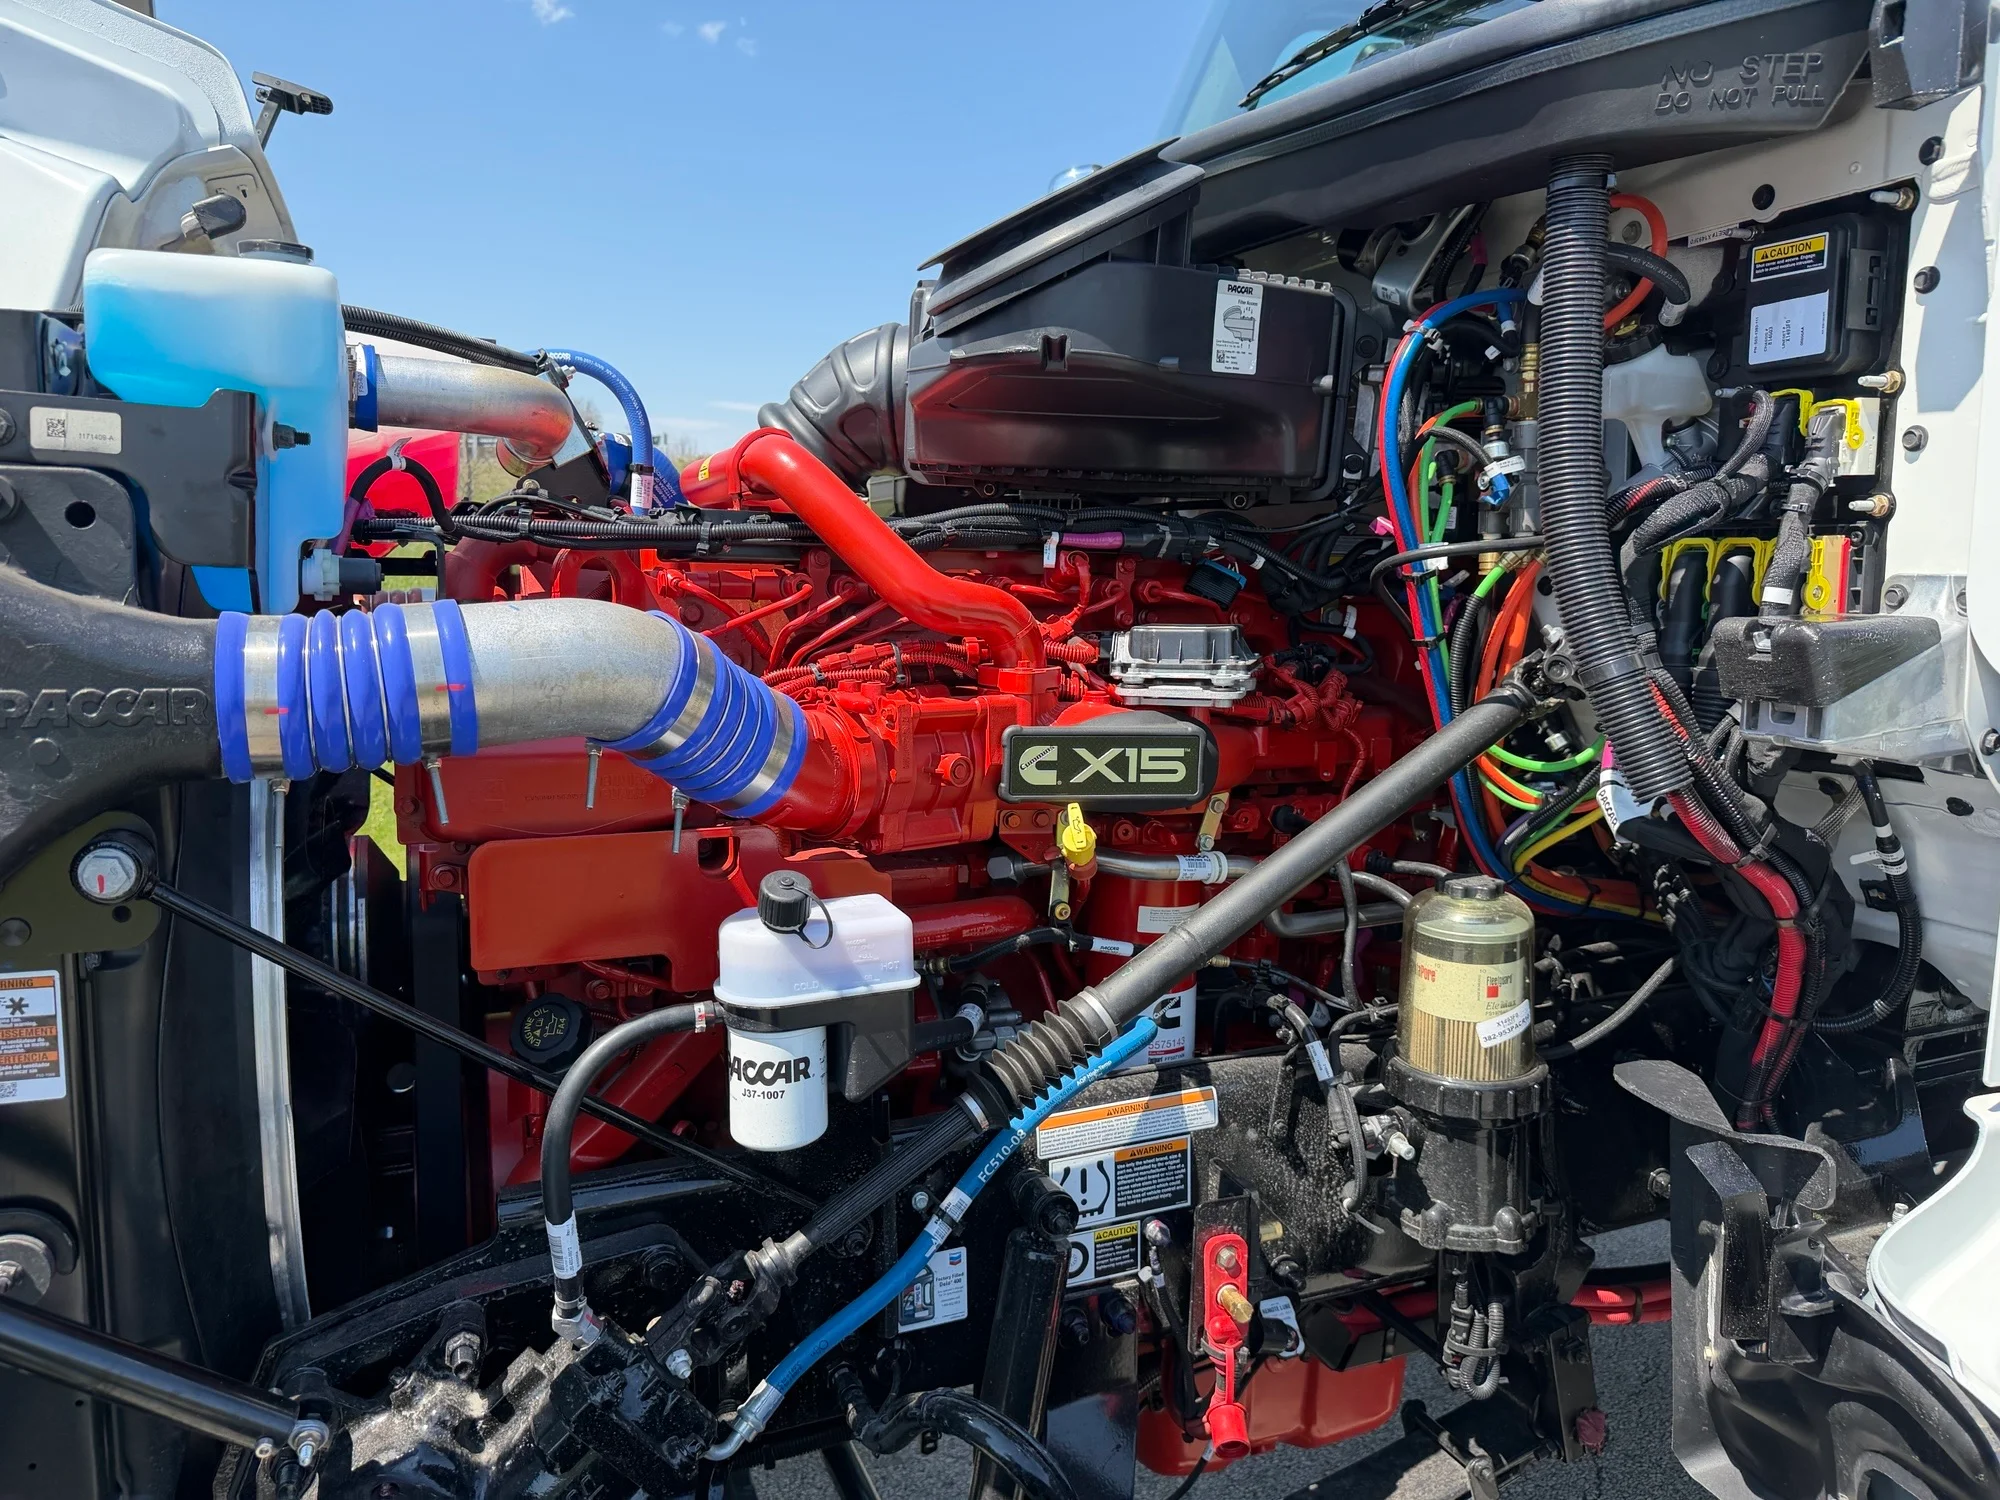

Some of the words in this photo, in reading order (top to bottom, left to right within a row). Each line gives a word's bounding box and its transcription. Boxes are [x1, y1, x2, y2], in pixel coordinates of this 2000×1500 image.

[1661, 59, 1715, 90] NO
[1739, 52, 1824, 85] STEP
[1654, 91, 1693, 116] DO
[1708, 86, 1759, 111] NOT
[1771, 84, 1826, 108] PULL
[1770, 242, 1812, 258] CAUTION
[1227, 284, 1254, 295] PACCAR
[0, 687, 210, 730] PACCAR
[1020, 745, 1055, 771] Cummins
[1069, 747, 1187, 783] X15
[1599, 789, 1618, 828] PACCAR
[793, 980, 820, 992] COLD
[1153, 996, 1180, 1019] Cummins
[524, 1016, 542, 1047] ENGINE
[533, 1008, 549, 1017] OIL
[556, 1018, 567, 1035] FA4
[728, 1054, 811, 1087] ACCAR
[742, 1088, 786, 1100] J37-1007
[1112, 1102, 1150, 1115] WARNING
[977, 1129, 1027, 1183] FC510-08
[1136, 1142, 1173, 1156] WARNING
[1102, 1225, 1137, 1237] CAUTION
